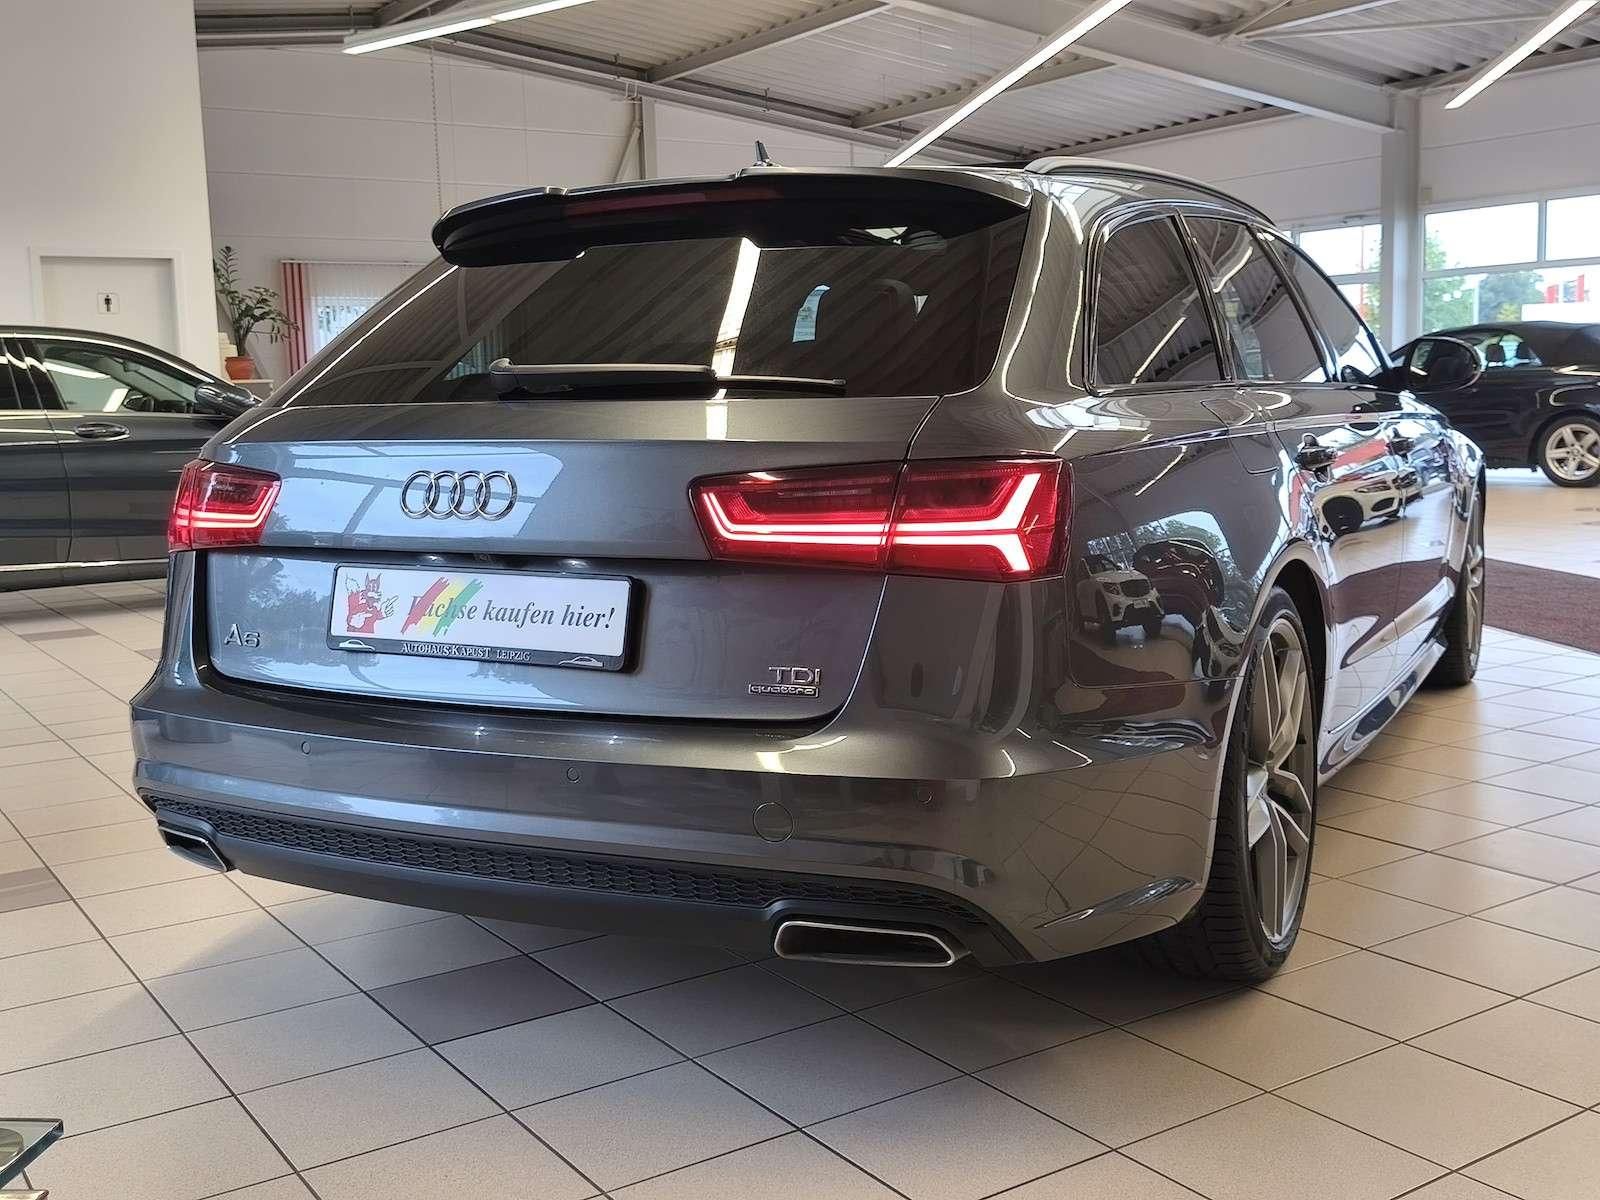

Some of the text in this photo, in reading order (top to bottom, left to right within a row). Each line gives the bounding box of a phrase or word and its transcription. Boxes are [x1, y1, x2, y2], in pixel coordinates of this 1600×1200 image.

[483, 600, 555, 629] kaufen
[561, 604, 615, 629] hier!
[224, 623, 260, 648] A6
[451, 645, 491, 659] KAPUST
[496, 649, 531, 661] LEIPZIG
[769, 666, 820, 685] TDI
[751, 685, 815, 695] quattro
